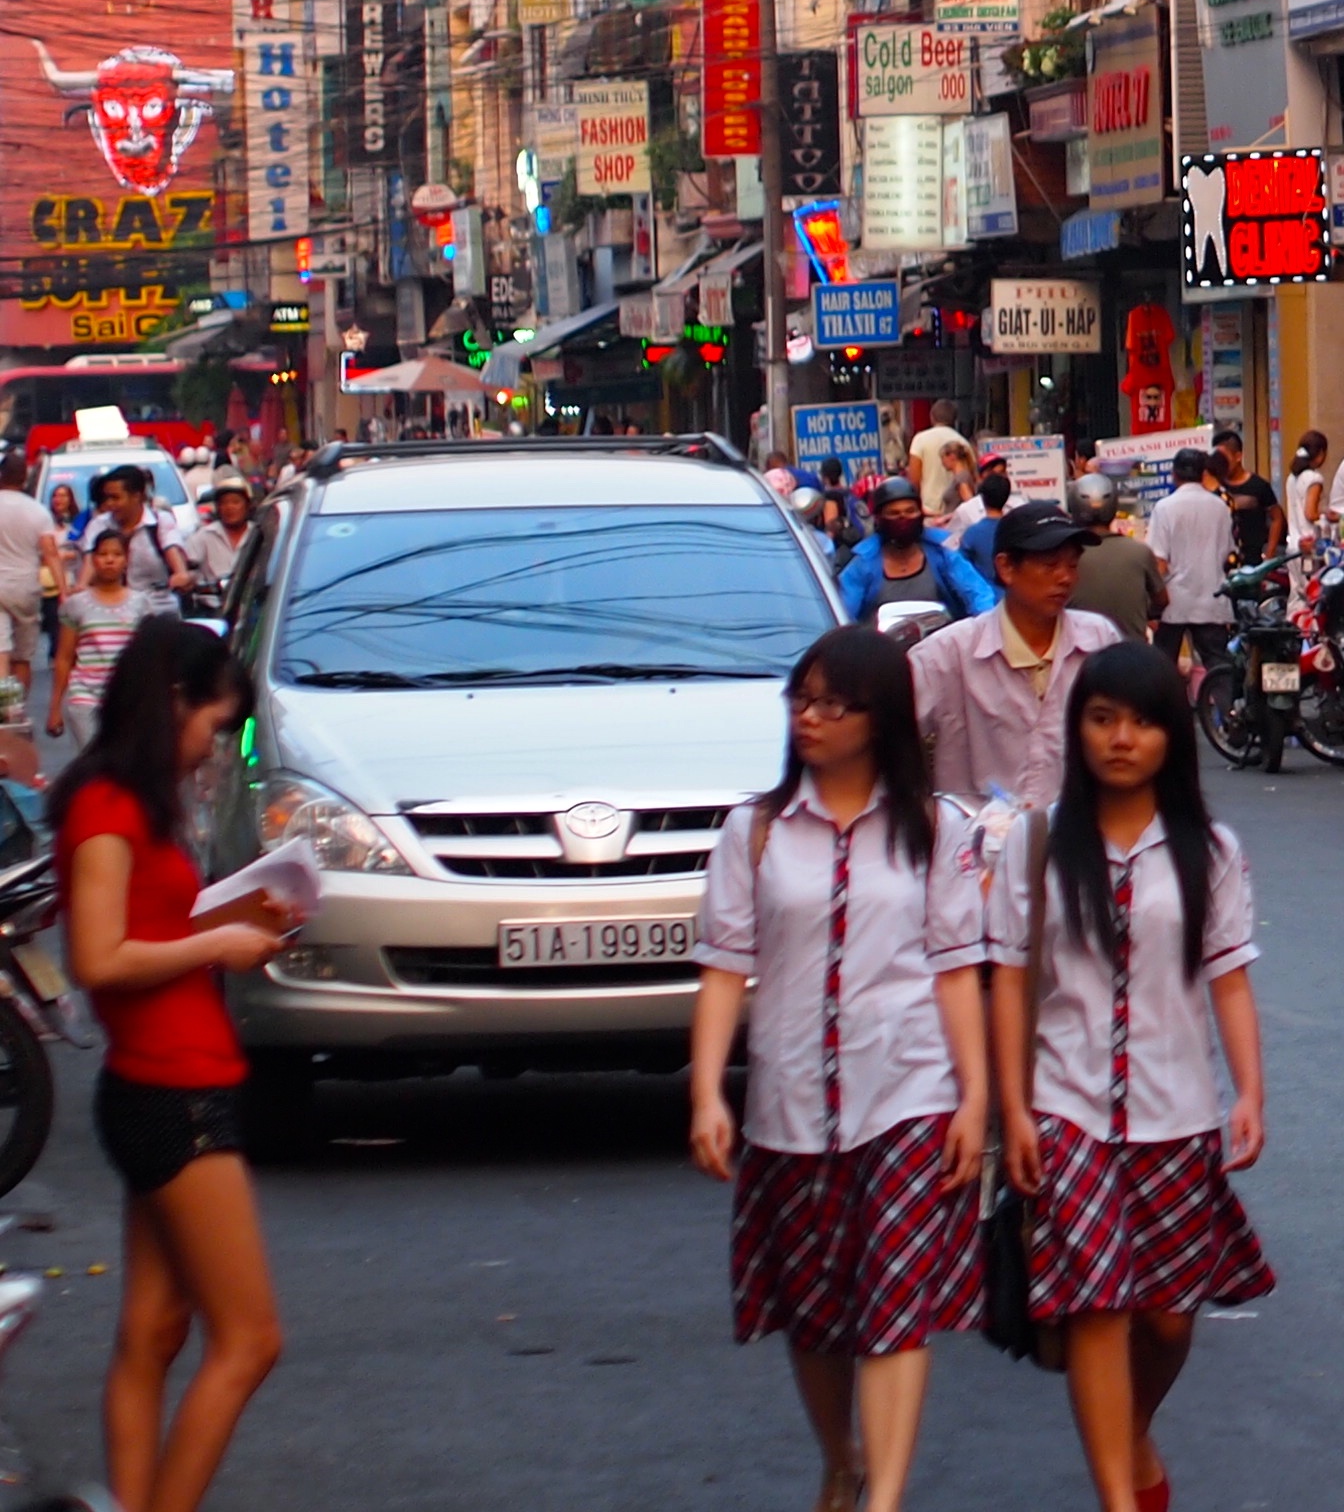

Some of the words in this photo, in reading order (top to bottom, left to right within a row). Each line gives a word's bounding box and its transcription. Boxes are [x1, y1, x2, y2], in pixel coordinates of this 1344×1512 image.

[863, 32, 912, 70] Cold
[921, 32, 965, 68] Beer
[865, 71, 913, 102] saigon
[257, 42, 295, 231] Hotel
[581, 116, 646, 146] FASHION
[593, 155, 635, 183] SHOP
[1225, 156, 1325, 217] DENTAL
[273, 307, 299, 322] ATM
[821, 292, 850, 311] HAIR
[853, 290, 892, 310] SALON
[822, 313, 875, 338] THANH
[800, 438, 833, 456] HAIR
[835, 433, 878, 454] SALON
[506, 921, 689, 961] 51A-199.99
